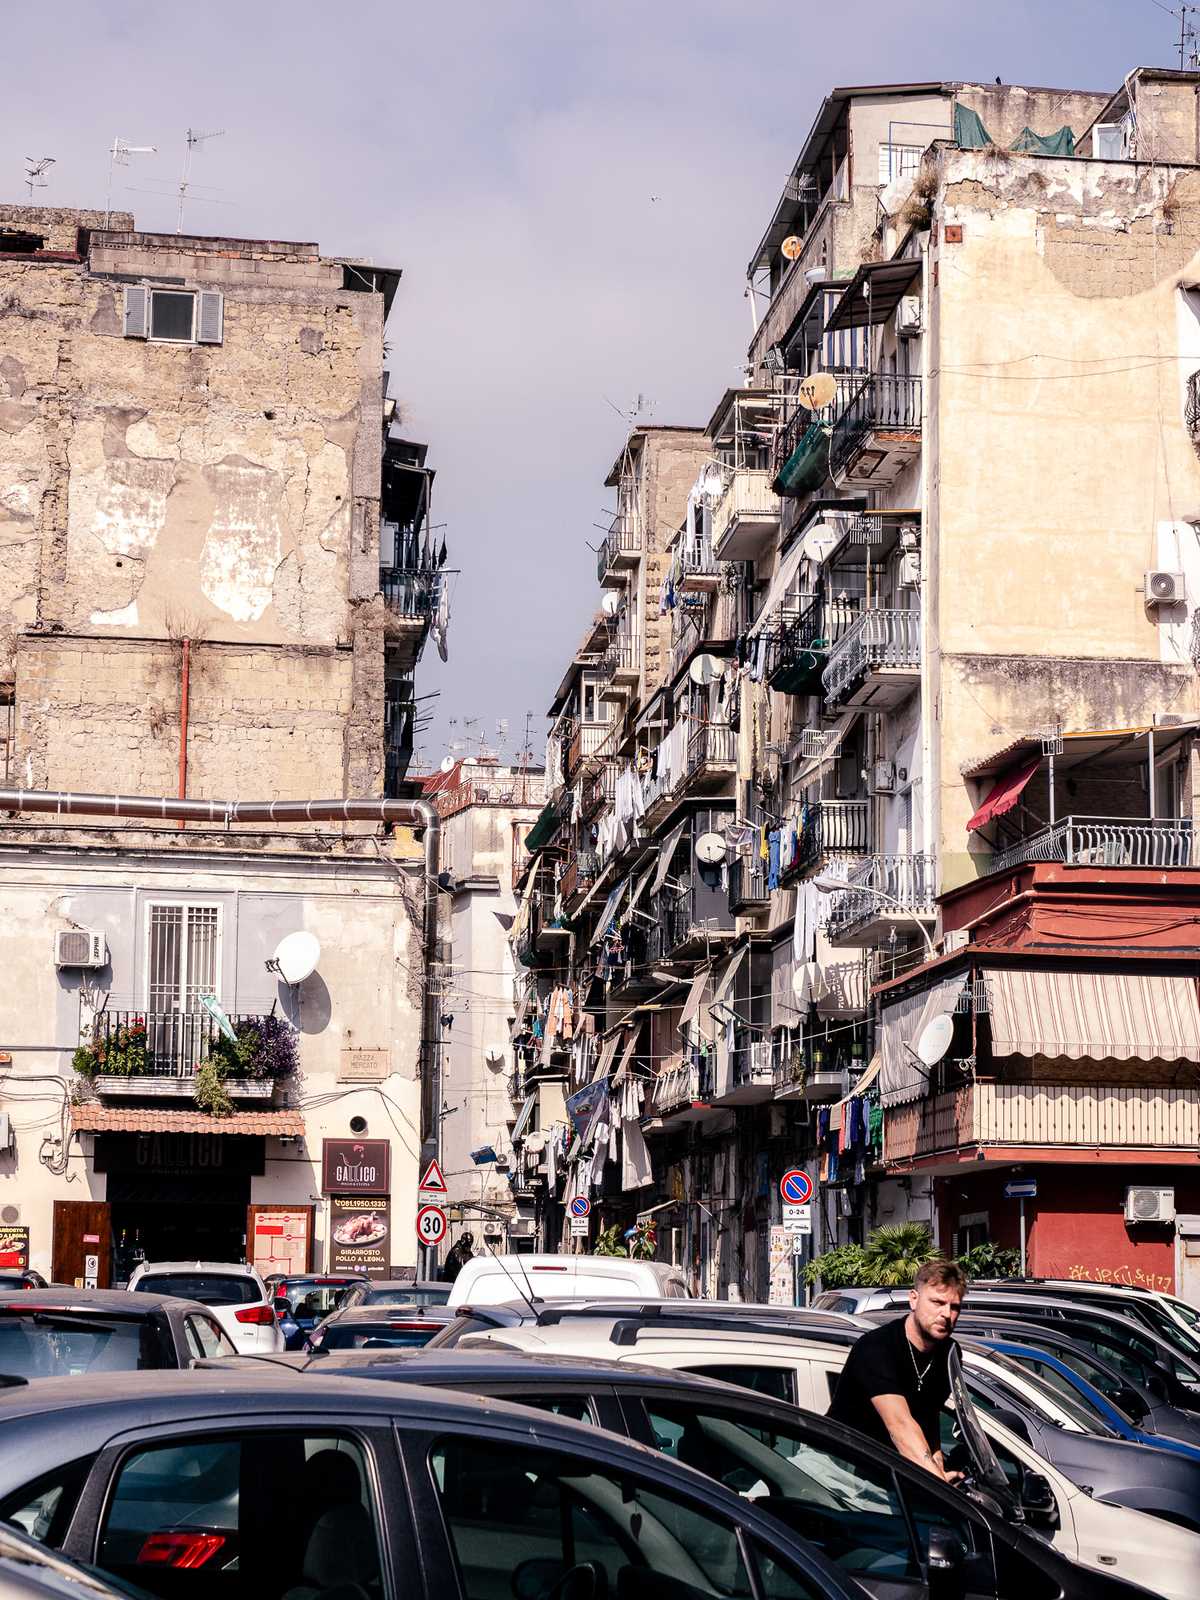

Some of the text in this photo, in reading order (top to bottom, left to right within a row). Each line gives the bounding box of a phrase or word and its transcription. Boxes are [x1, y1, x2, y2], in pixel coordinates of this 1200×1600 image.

[136, 1136, 225, 1168] GALLICO
[336, 1166, 376, 1182] GALLICO
[423, 1217, 441, 1234] 30
